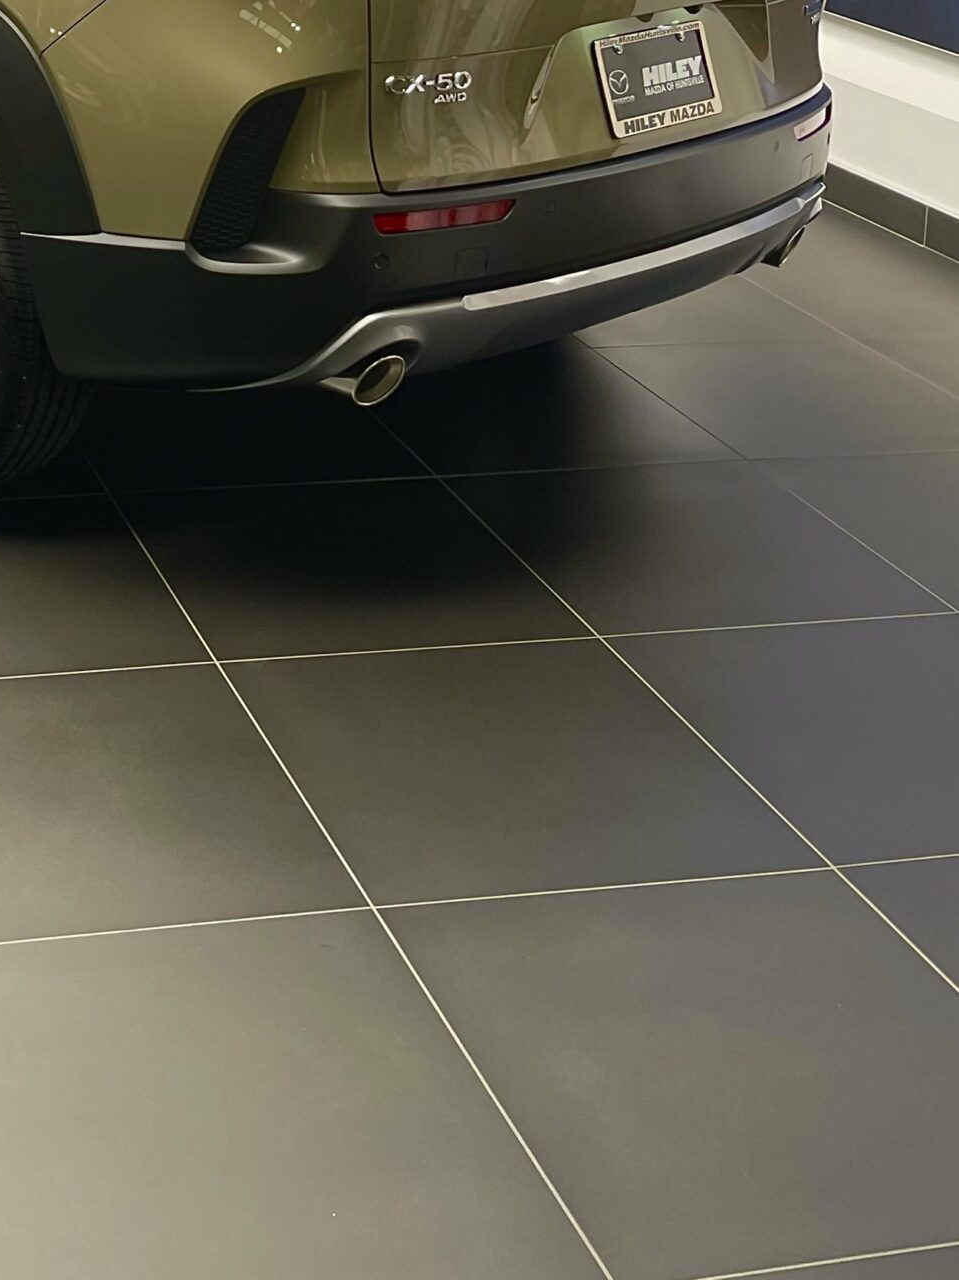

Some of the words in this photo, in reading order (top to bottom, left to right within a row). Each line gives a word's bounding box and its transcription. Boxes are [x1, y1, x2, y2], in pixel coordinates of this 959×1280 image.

[385, 71, 472, 94] CX-50
[642, 55, 702, 87] HILEY
[644, 84, 667, 96] MAZDA
[666, 81, 675, 91] OF
[674, 75, 705, 89] HUNTSVILLE
[434, 92, 467, 104] AWD
[623, 112, 666, 134] HILEY
[670, 101, 715, 123] MAZDA
